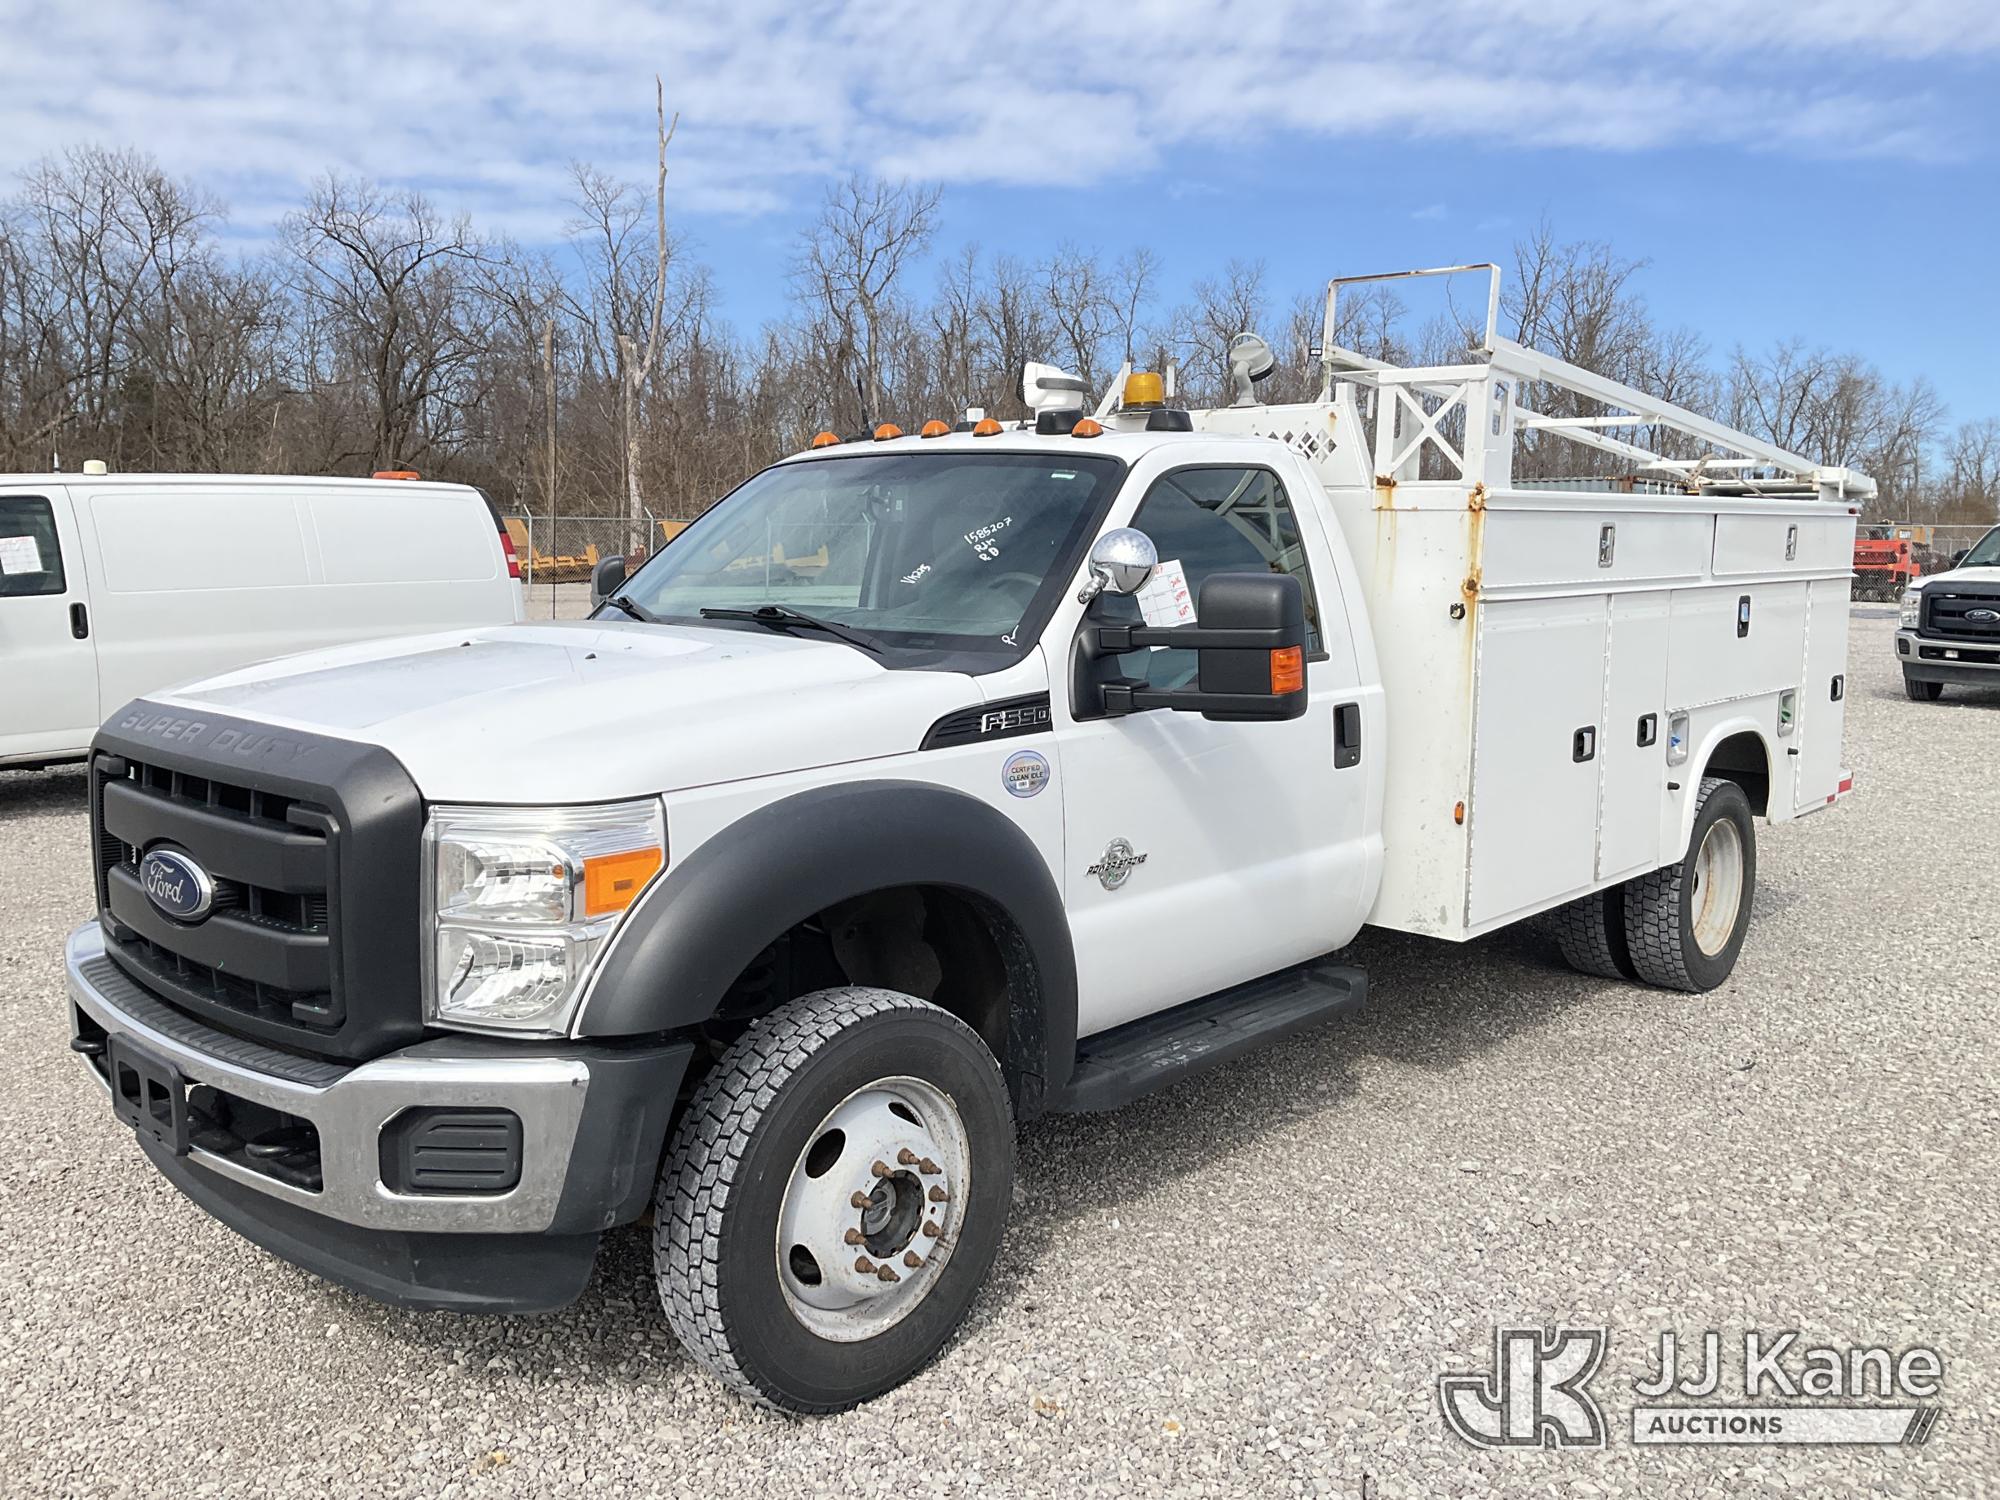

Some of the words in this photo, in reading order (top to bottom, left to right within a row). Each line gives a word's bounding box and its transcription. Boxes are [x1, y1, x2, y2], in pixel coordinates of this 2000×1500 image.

[964, 516, 1013, 545] 1585207
[980, 705, 1051, 733] F-550
[121, 711, 208, 744] SUPER
[208, 727, 319, 761] DUTY
[1009, 774, 1029, 782] CLEAN
[1011, 764, 1041, 774] CERTIFIED
[147, 860, 183, 904] Ford
